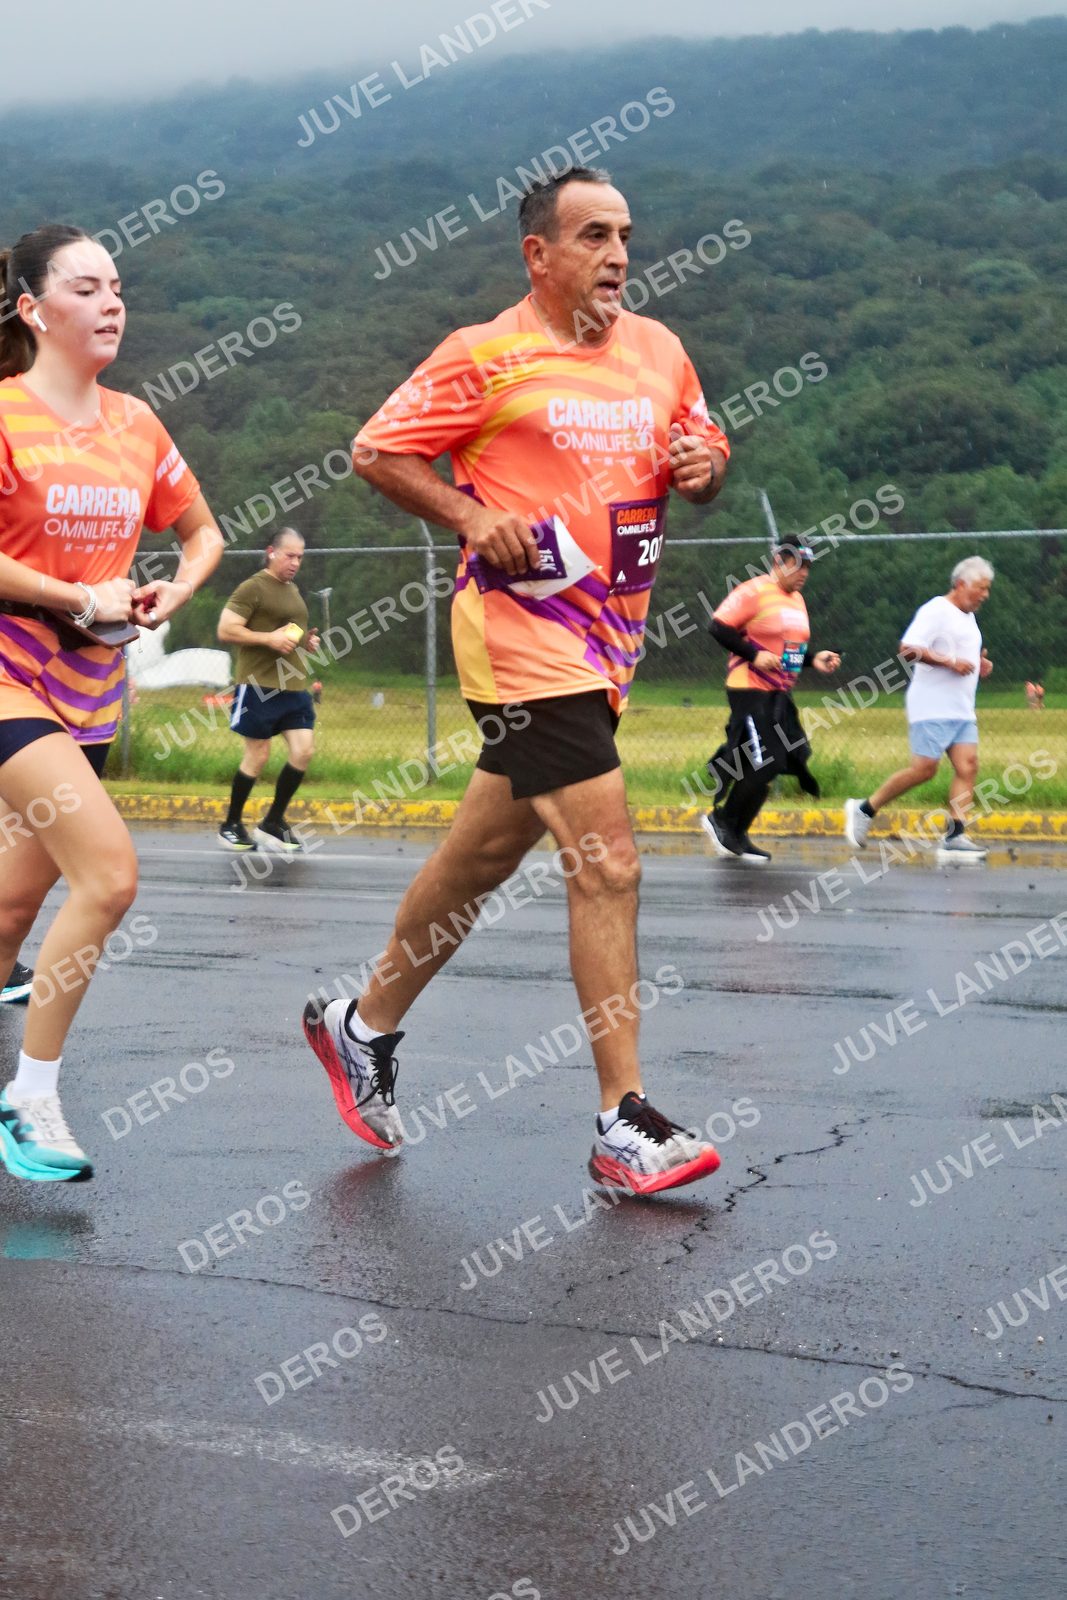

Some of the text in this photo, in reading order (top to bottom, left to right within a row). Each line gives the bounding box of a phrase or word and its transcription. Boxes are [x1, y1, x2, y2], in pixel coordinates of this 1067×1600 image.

[548, 397, 655, 429] CARRERA
[552, 431, 632, 453] OMNILIFE
[46, 484, 140, 516] CARRERA
[616, 507, 657, 525] CARRERA
[44, 518, 120, 539] OMNILIFE
[538, 549, 557, 572] 15K
